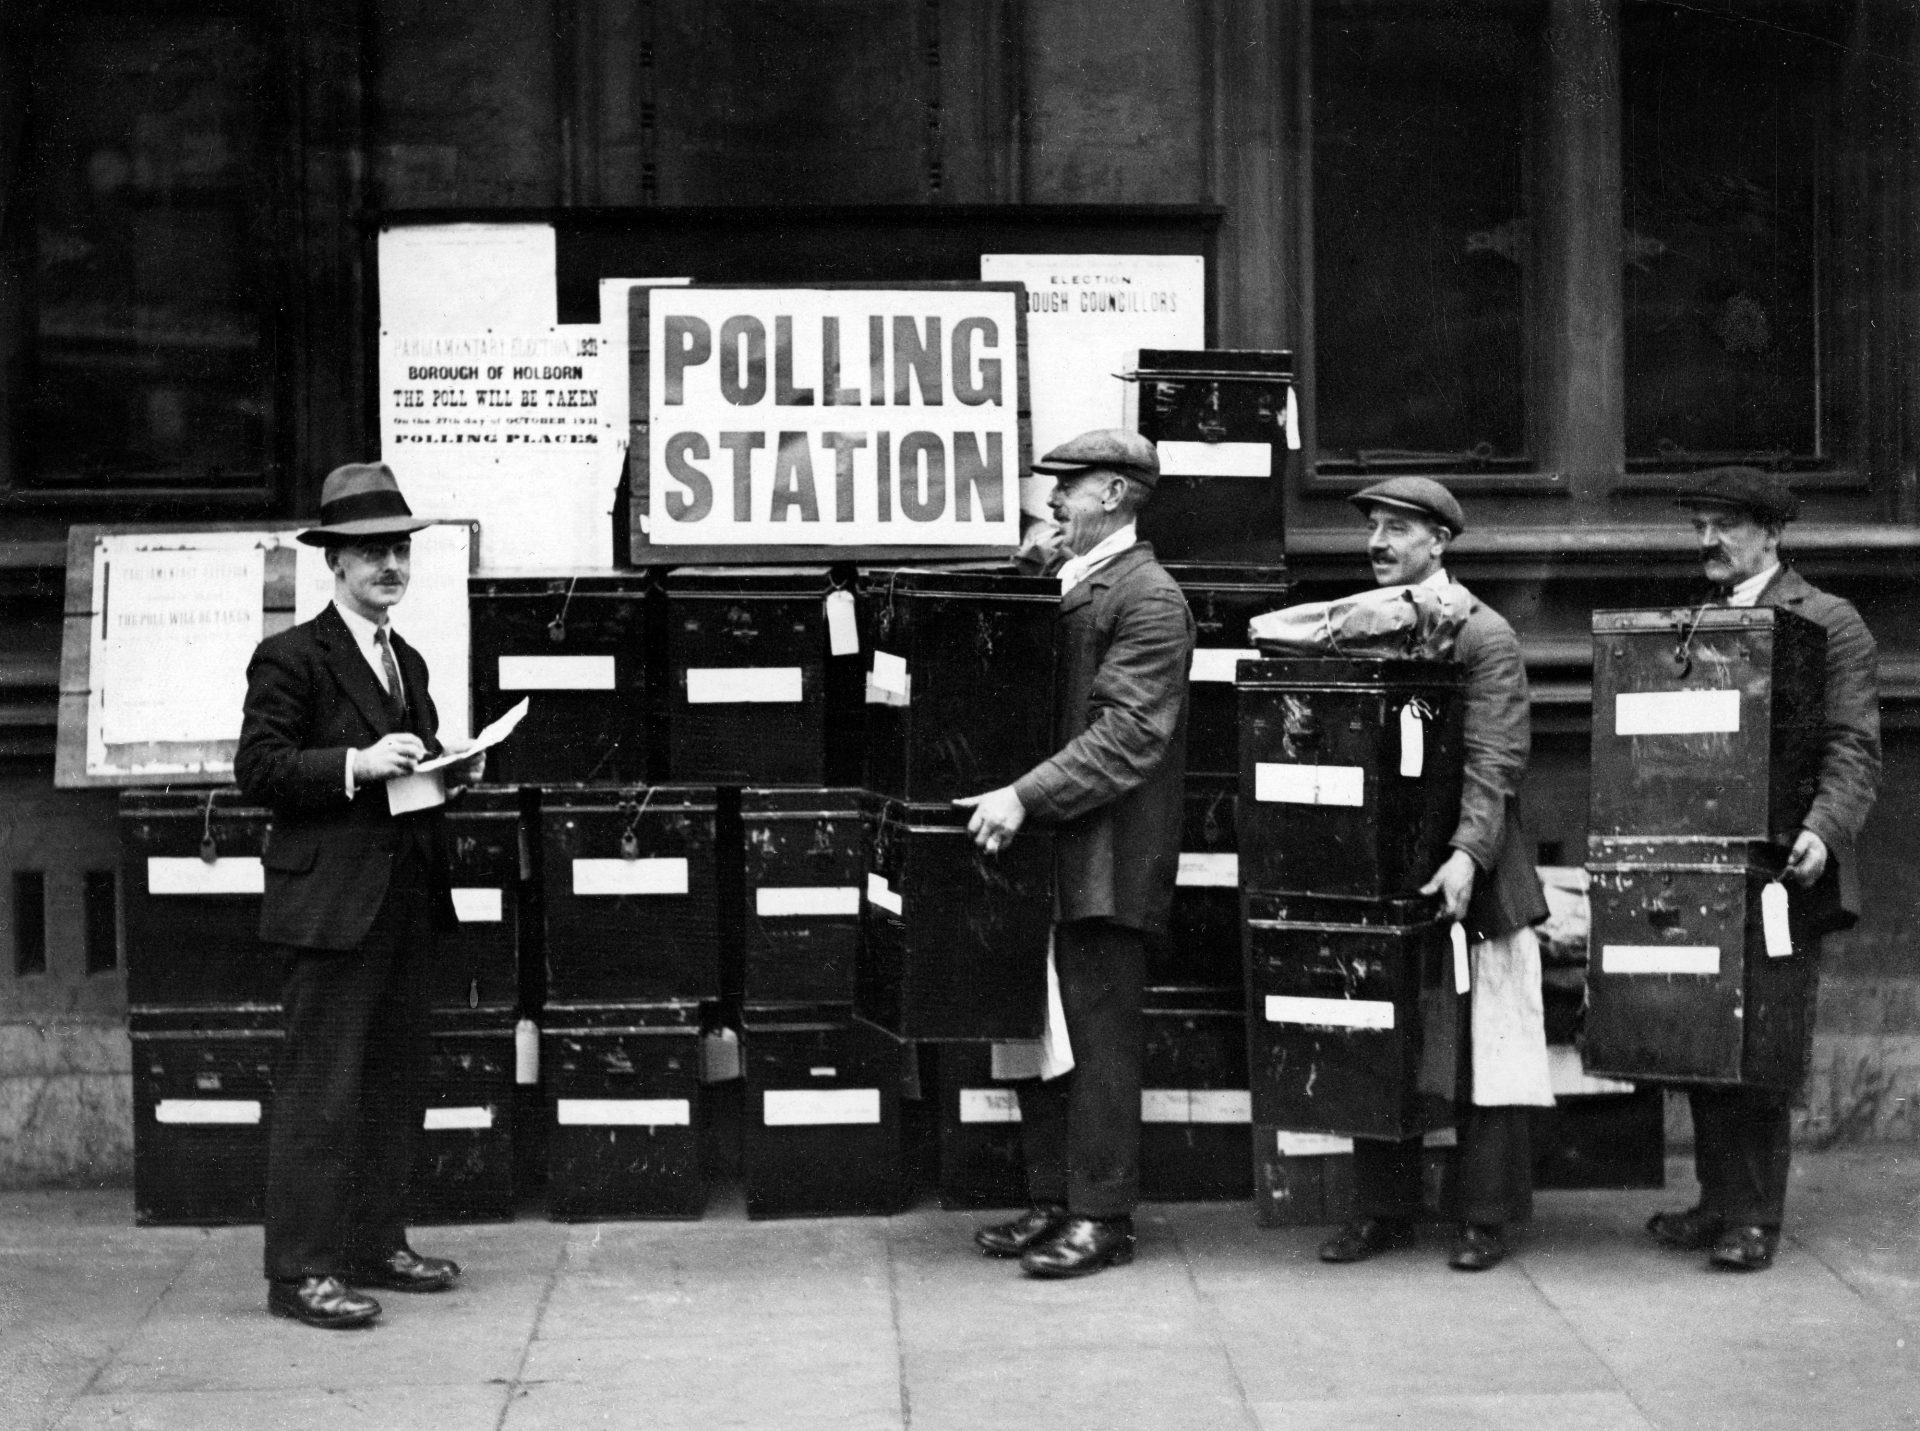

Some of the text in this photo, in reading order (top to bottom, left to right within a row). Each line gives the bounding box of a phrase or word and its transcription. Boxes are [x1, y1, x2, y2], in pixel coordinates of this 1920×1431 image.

[1050, 275, 1132, 285] ELECTION
[1080, 290, 1178, 313] COUNCILLORS
[664, 315, 1003, 407] POLLING
[408, 366, 583, 380] BOROUGH OF HOLBORN
[393, 389, 599, 407] THE POLL WILL BE TAKEN
[506, 417, 566, 425] OCTOBER
[394, 434, 599, 444] POLLING PLACES
[664, 431, 1005, 522] STATION
